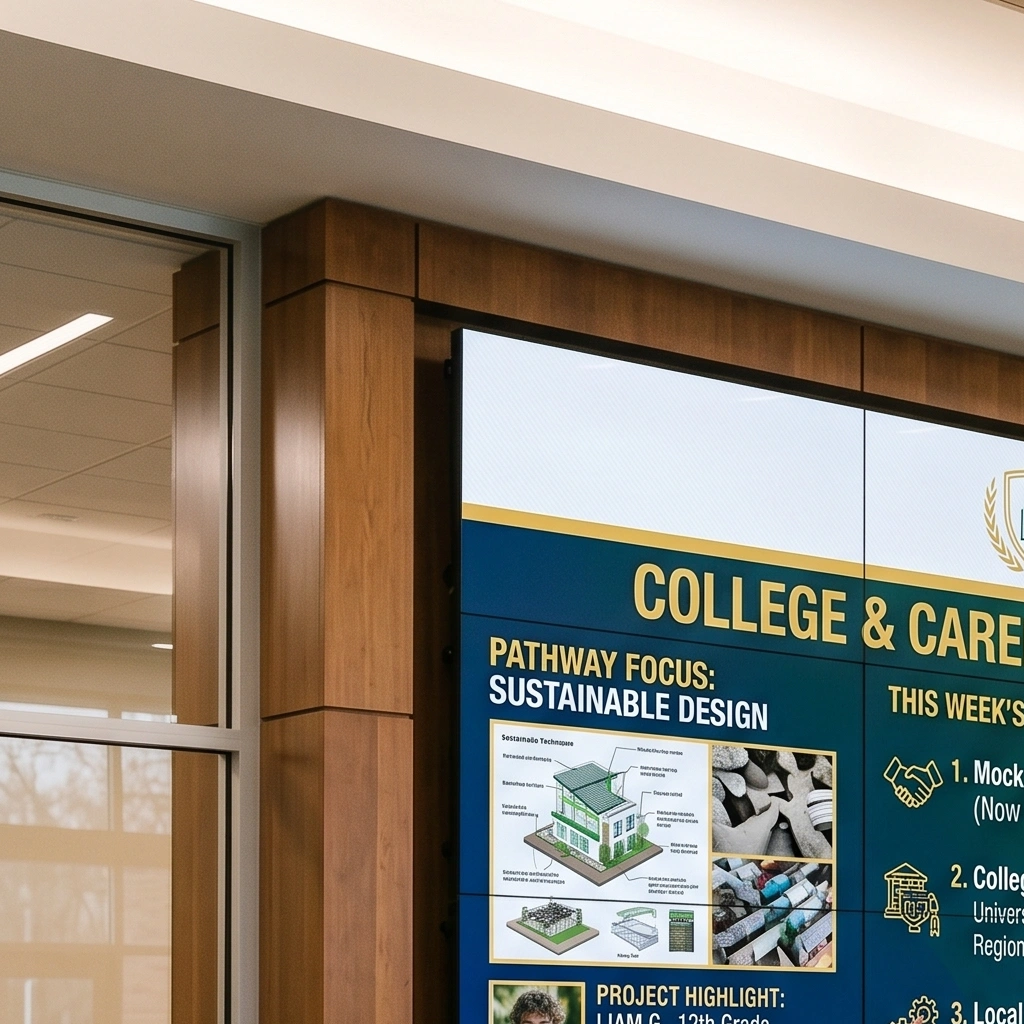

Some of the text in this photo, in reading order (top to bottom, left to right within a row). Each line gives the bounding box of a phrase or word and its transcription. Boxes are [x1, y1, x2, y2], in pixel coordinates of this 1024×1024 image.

[633, 562, 848, 645] COLLEGE
[861, 596, 895, 651] &
[490, 636, 715, 690] PATHWAY FOCUS:
[489, 675, 769, 731] SUSTAINABLE DESIGN
[888, 685, 939, 718] THIS
[951, 759, 968, 783] 1.
[973, 759, 1024, 789] Mock
[973, 795, 1020, 826] (Now
[950, 864, 967, 889] 2.
[596, 985, 785, 1008] PROJECT HIGHLIGHT:
